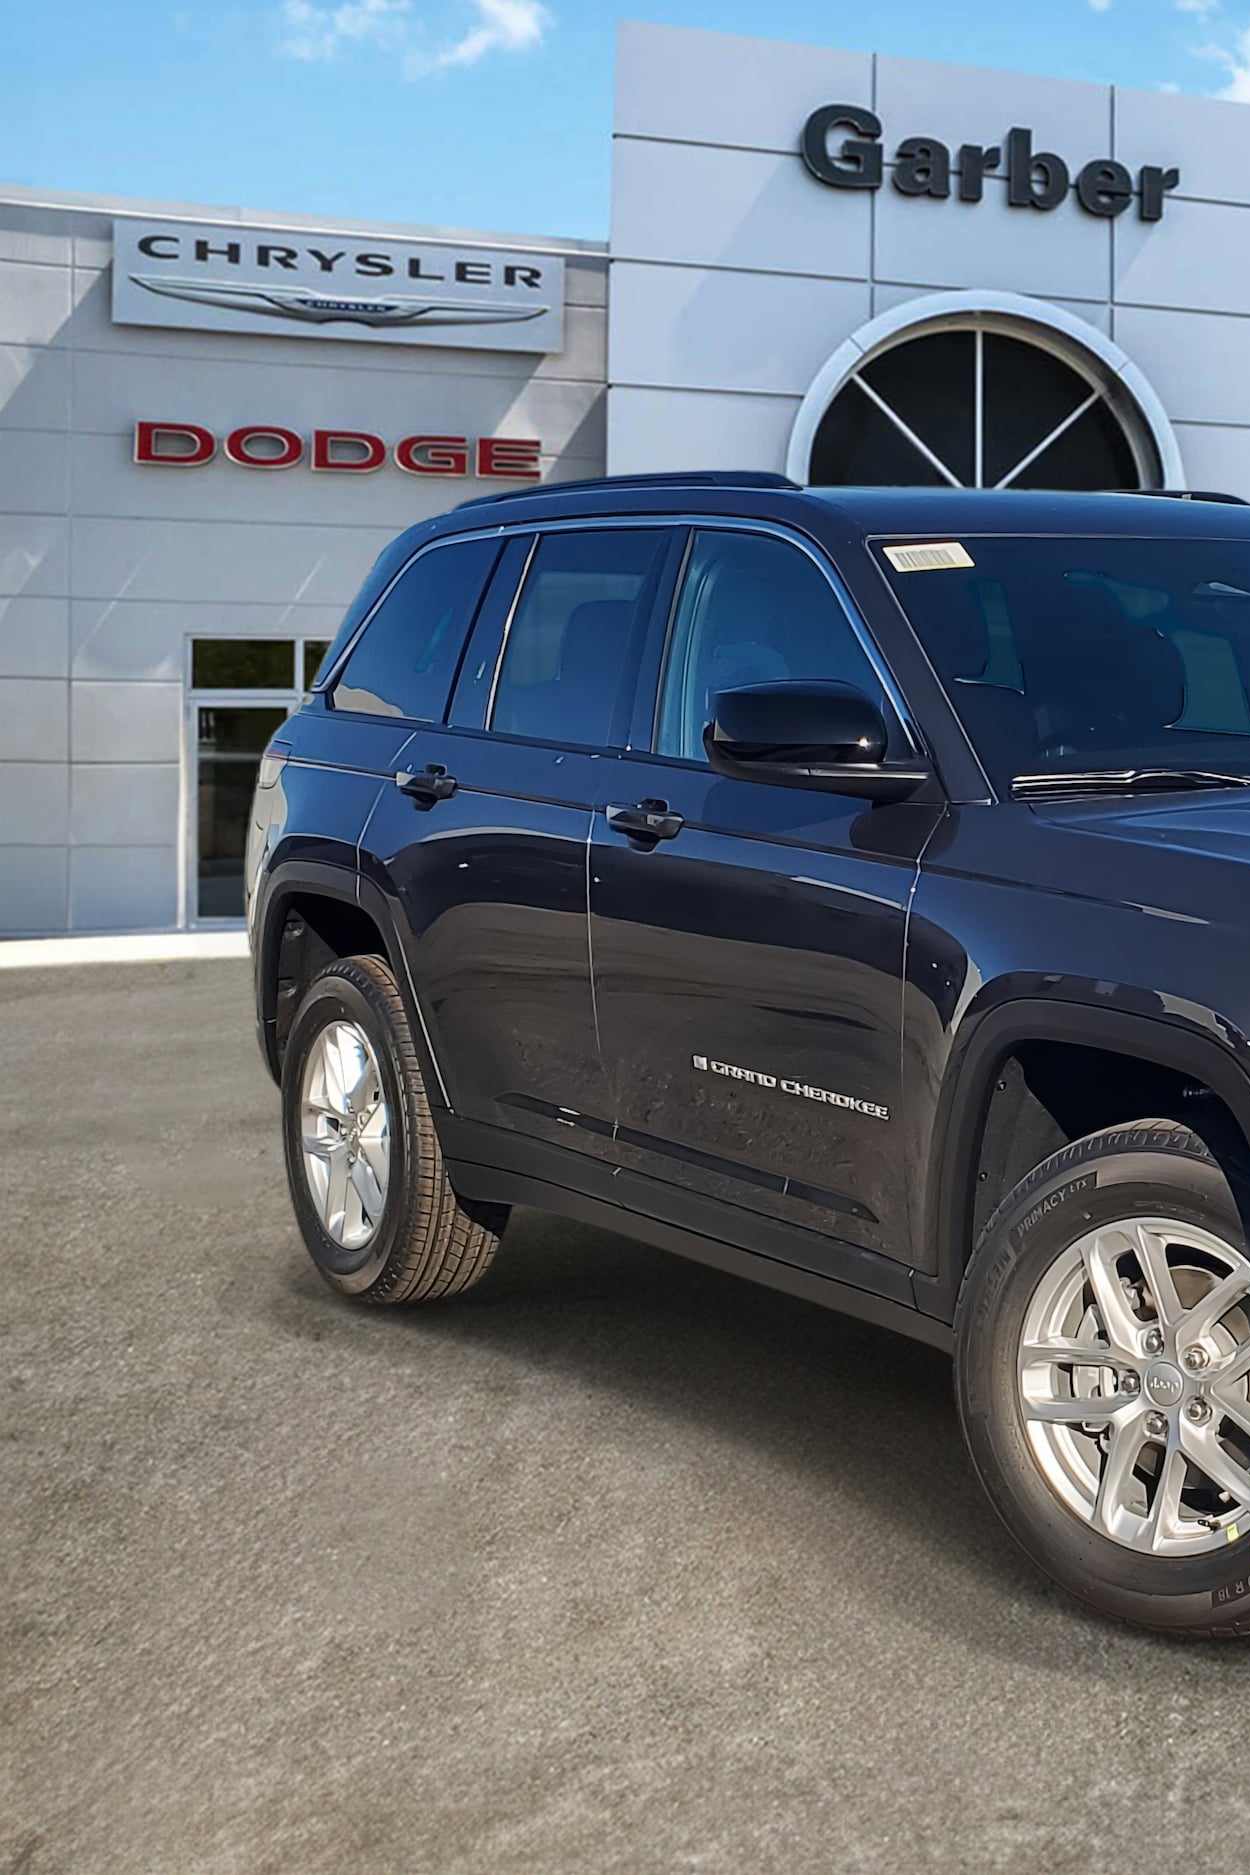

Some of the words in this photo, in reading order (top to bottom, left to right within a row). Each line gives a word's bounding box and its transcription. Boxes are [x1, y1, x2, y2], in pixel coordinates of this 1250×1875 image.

[802, 103, 1180, 222] Garber
[137, 234, 544, 289] CHRYSLER
[134, 421, 542, 479] DODGE
[710, 1060, 777, 1088] GRAND
[780, 1079, 890, 1121] CHEROKEE
[1017, 1188, 1066, 1238] PRIMACY
[1069, 1178, 1088, 1193] LTX
[1235, 1581, 1245, 1594] R
